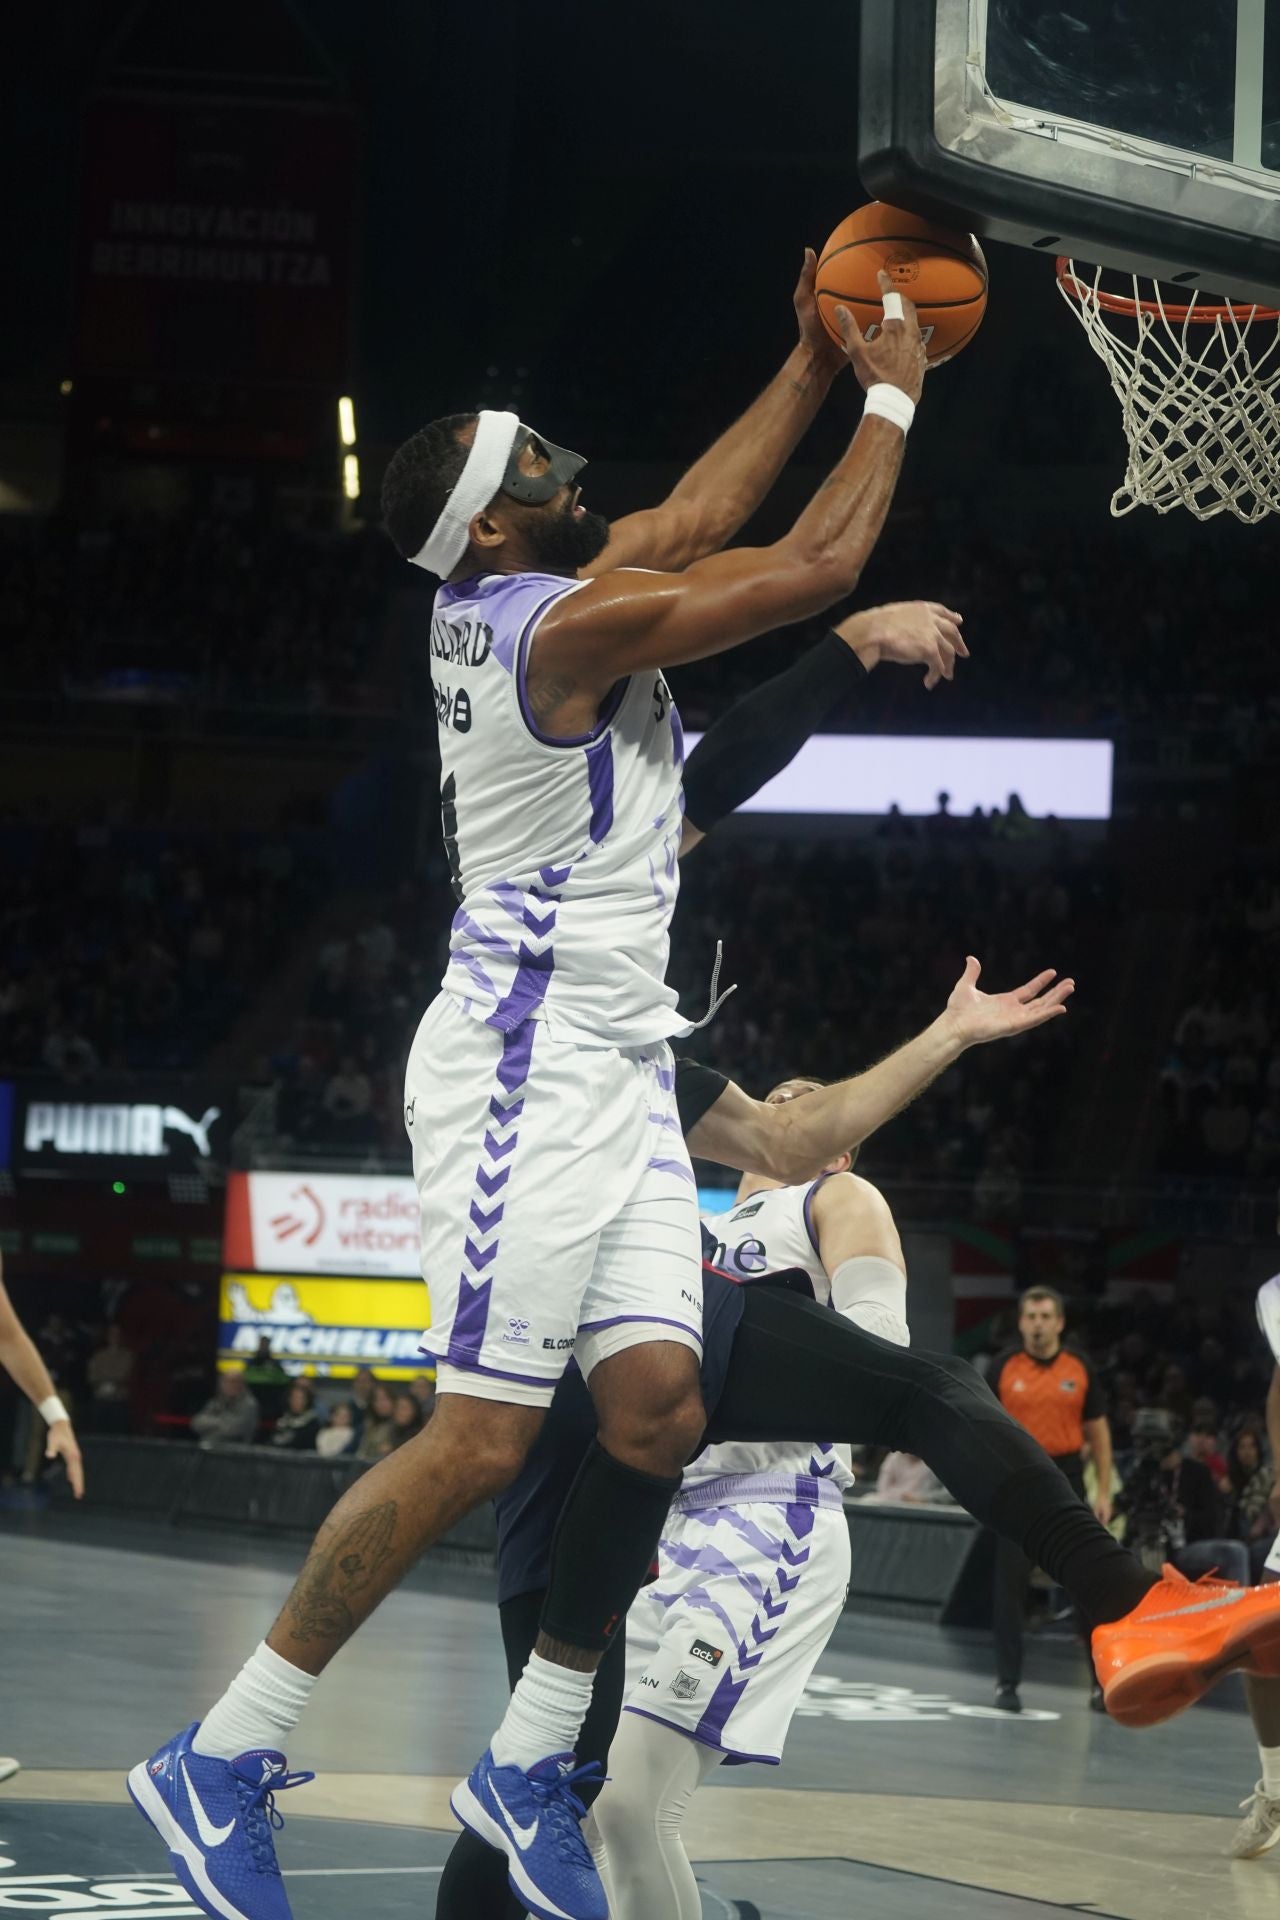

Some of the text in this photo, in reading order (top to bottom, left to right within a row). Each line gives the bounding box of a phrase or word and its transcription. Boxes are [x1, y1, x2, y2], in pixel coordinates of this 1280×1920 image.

[111, 198, 317, 244] INNOVACIÓN
[24, 1102, 164, 1156] PUMA
[542, 1338, 556, 1349] EL
[692, 1646, 714, 1662] acb
